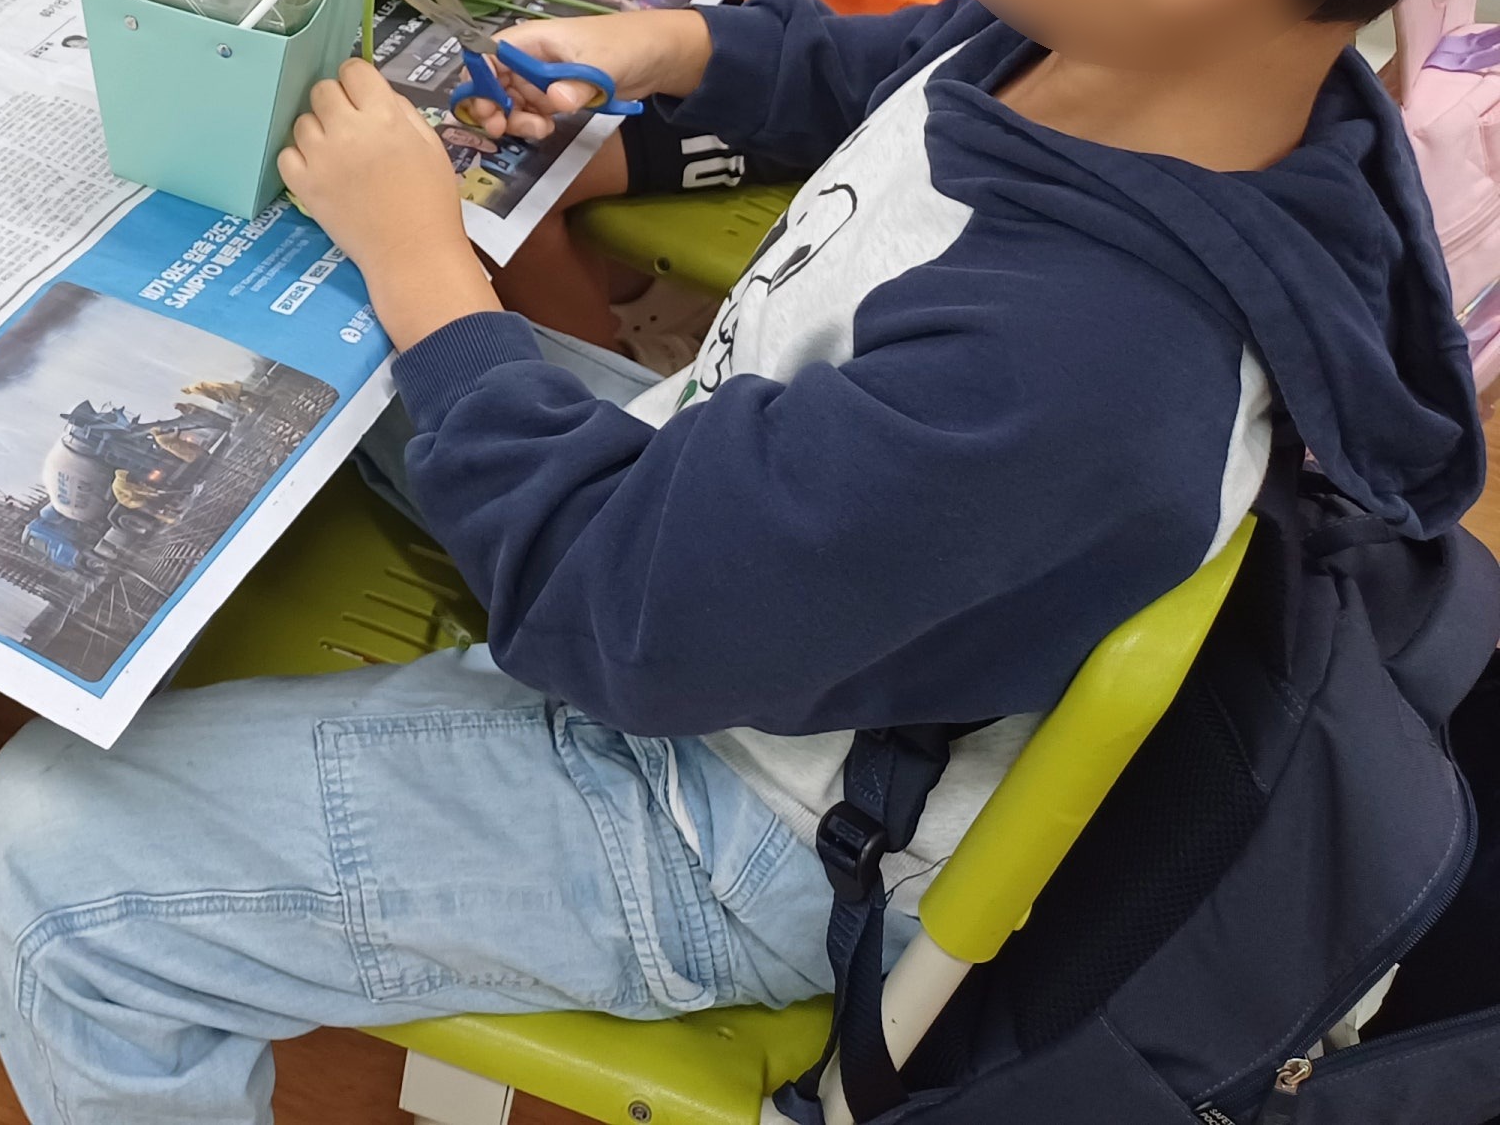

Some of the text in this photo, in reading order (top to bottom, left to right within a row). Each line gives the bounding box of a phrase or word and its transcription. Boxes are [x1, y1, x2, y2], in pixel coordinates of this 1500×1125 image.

[138, 277, 173, 301] 비가
[161, 261, 196, 284] 와도
[182, 240, 217, 264] 압축
[203, 221, 235, 243] 강도
[164, 263, 223, 309] SAMPYO
